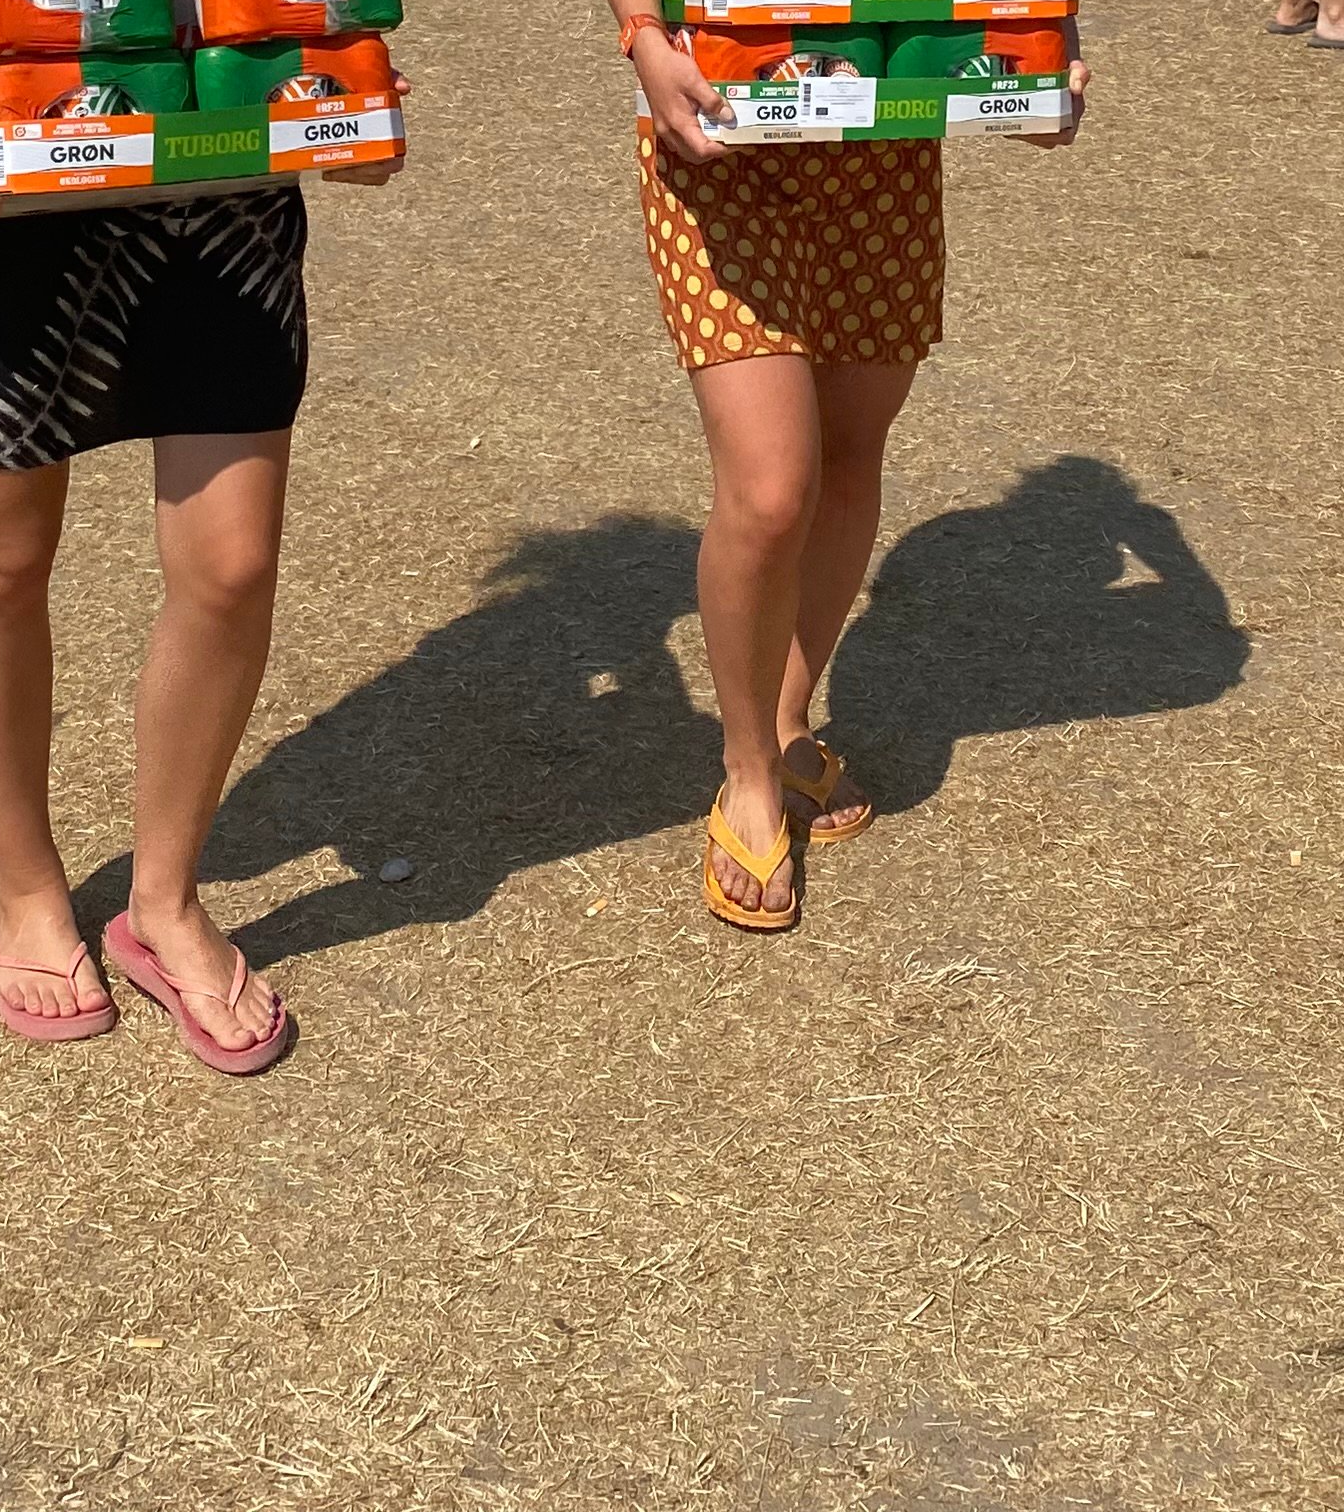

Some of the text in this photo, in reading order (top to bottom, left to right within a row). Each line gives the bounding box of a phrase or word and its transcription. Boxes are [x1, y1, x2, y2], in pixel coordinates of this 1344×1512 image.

[756, 104, 797, 121] GRØ
[979, 98, 1030, 115] GRØN
[304, 120, 359, 142] GRØN
[50, 143, 115, 164] GRØN
[163, 128, 261, 160] TUBORG
